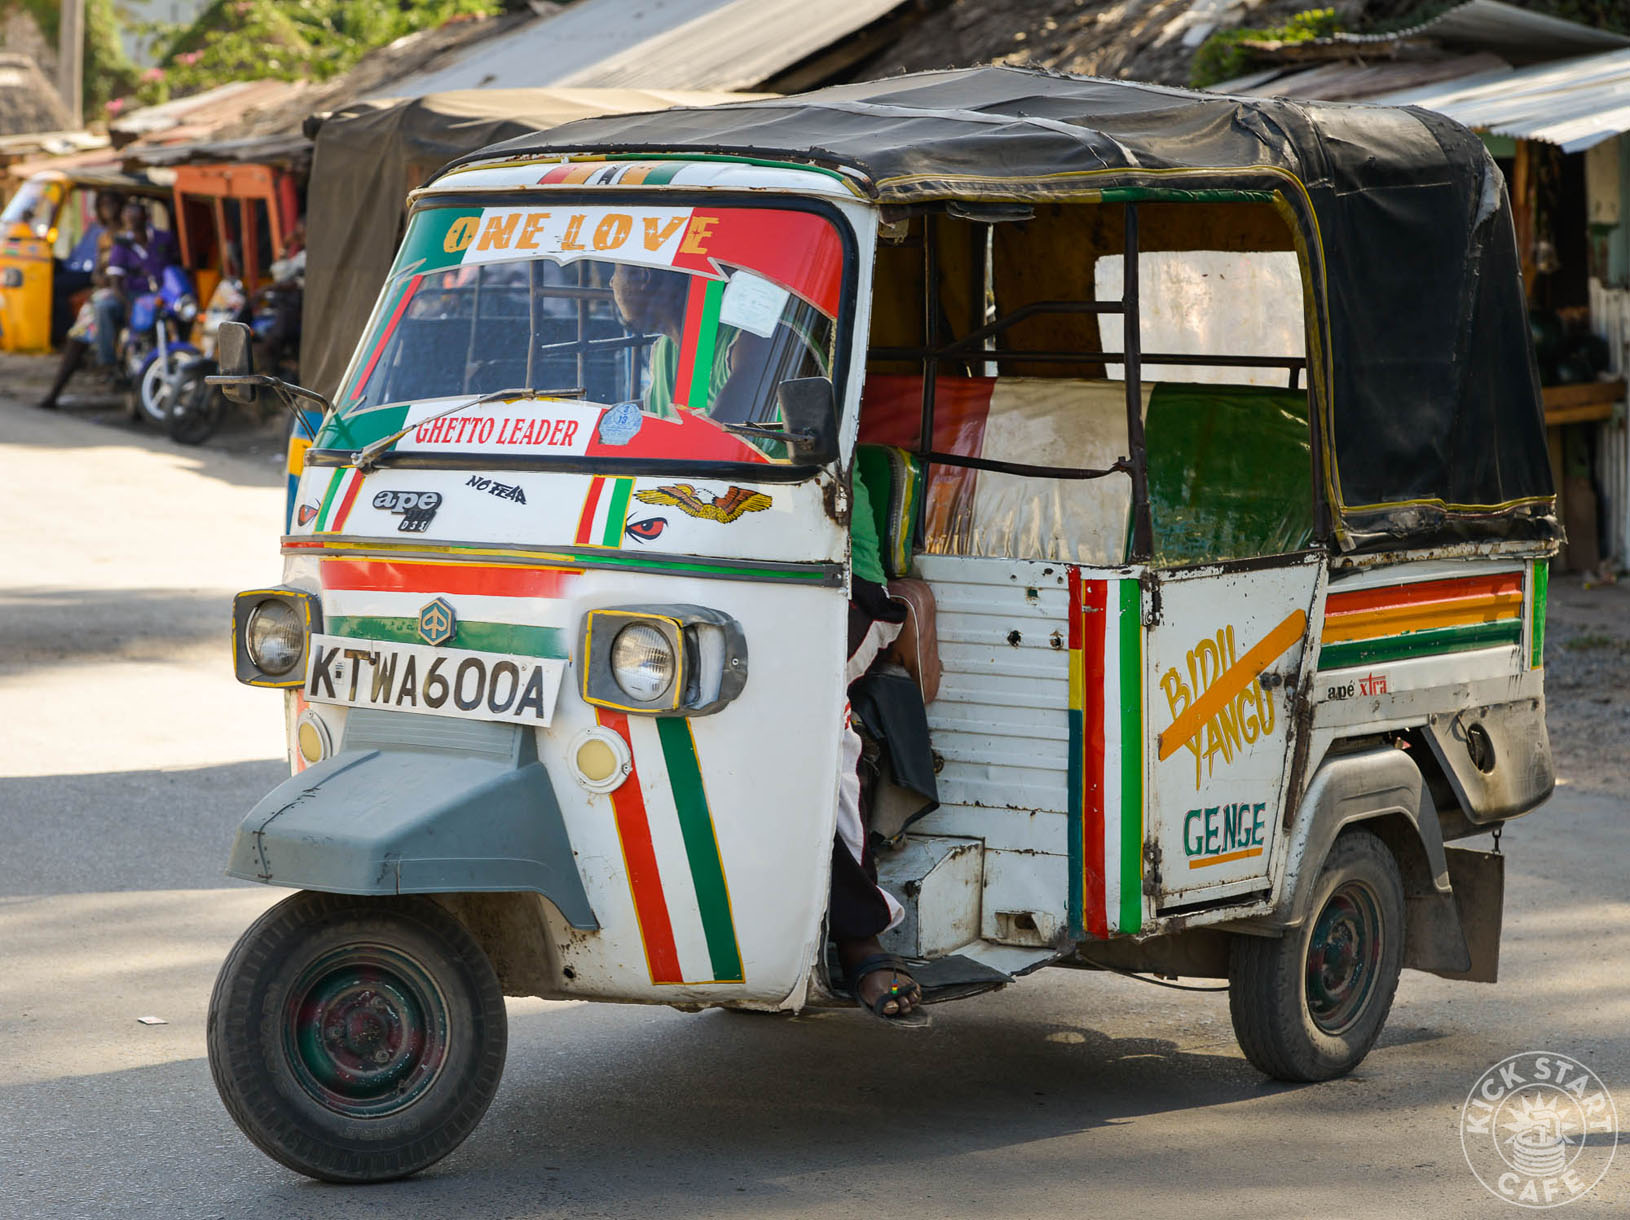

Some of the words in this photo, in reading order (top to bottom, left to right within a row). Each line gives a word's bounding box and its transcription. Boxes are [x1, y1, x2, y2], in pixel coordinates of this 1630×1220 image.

[443, 212, 551, 253] ONE
[560, 213, 720, 254] LOVE
[415, 416, 495, 444] GHETTO
[496, 417, 579, 447] LEADER
[465, 475, 492, 491] NO
[373, 491, 438, 513] ape
[310, 645, 545, 719] KTWA600A
[1359, 672, 1387, 696] xtra
[1184, 802, 1266, 857] GENGE
